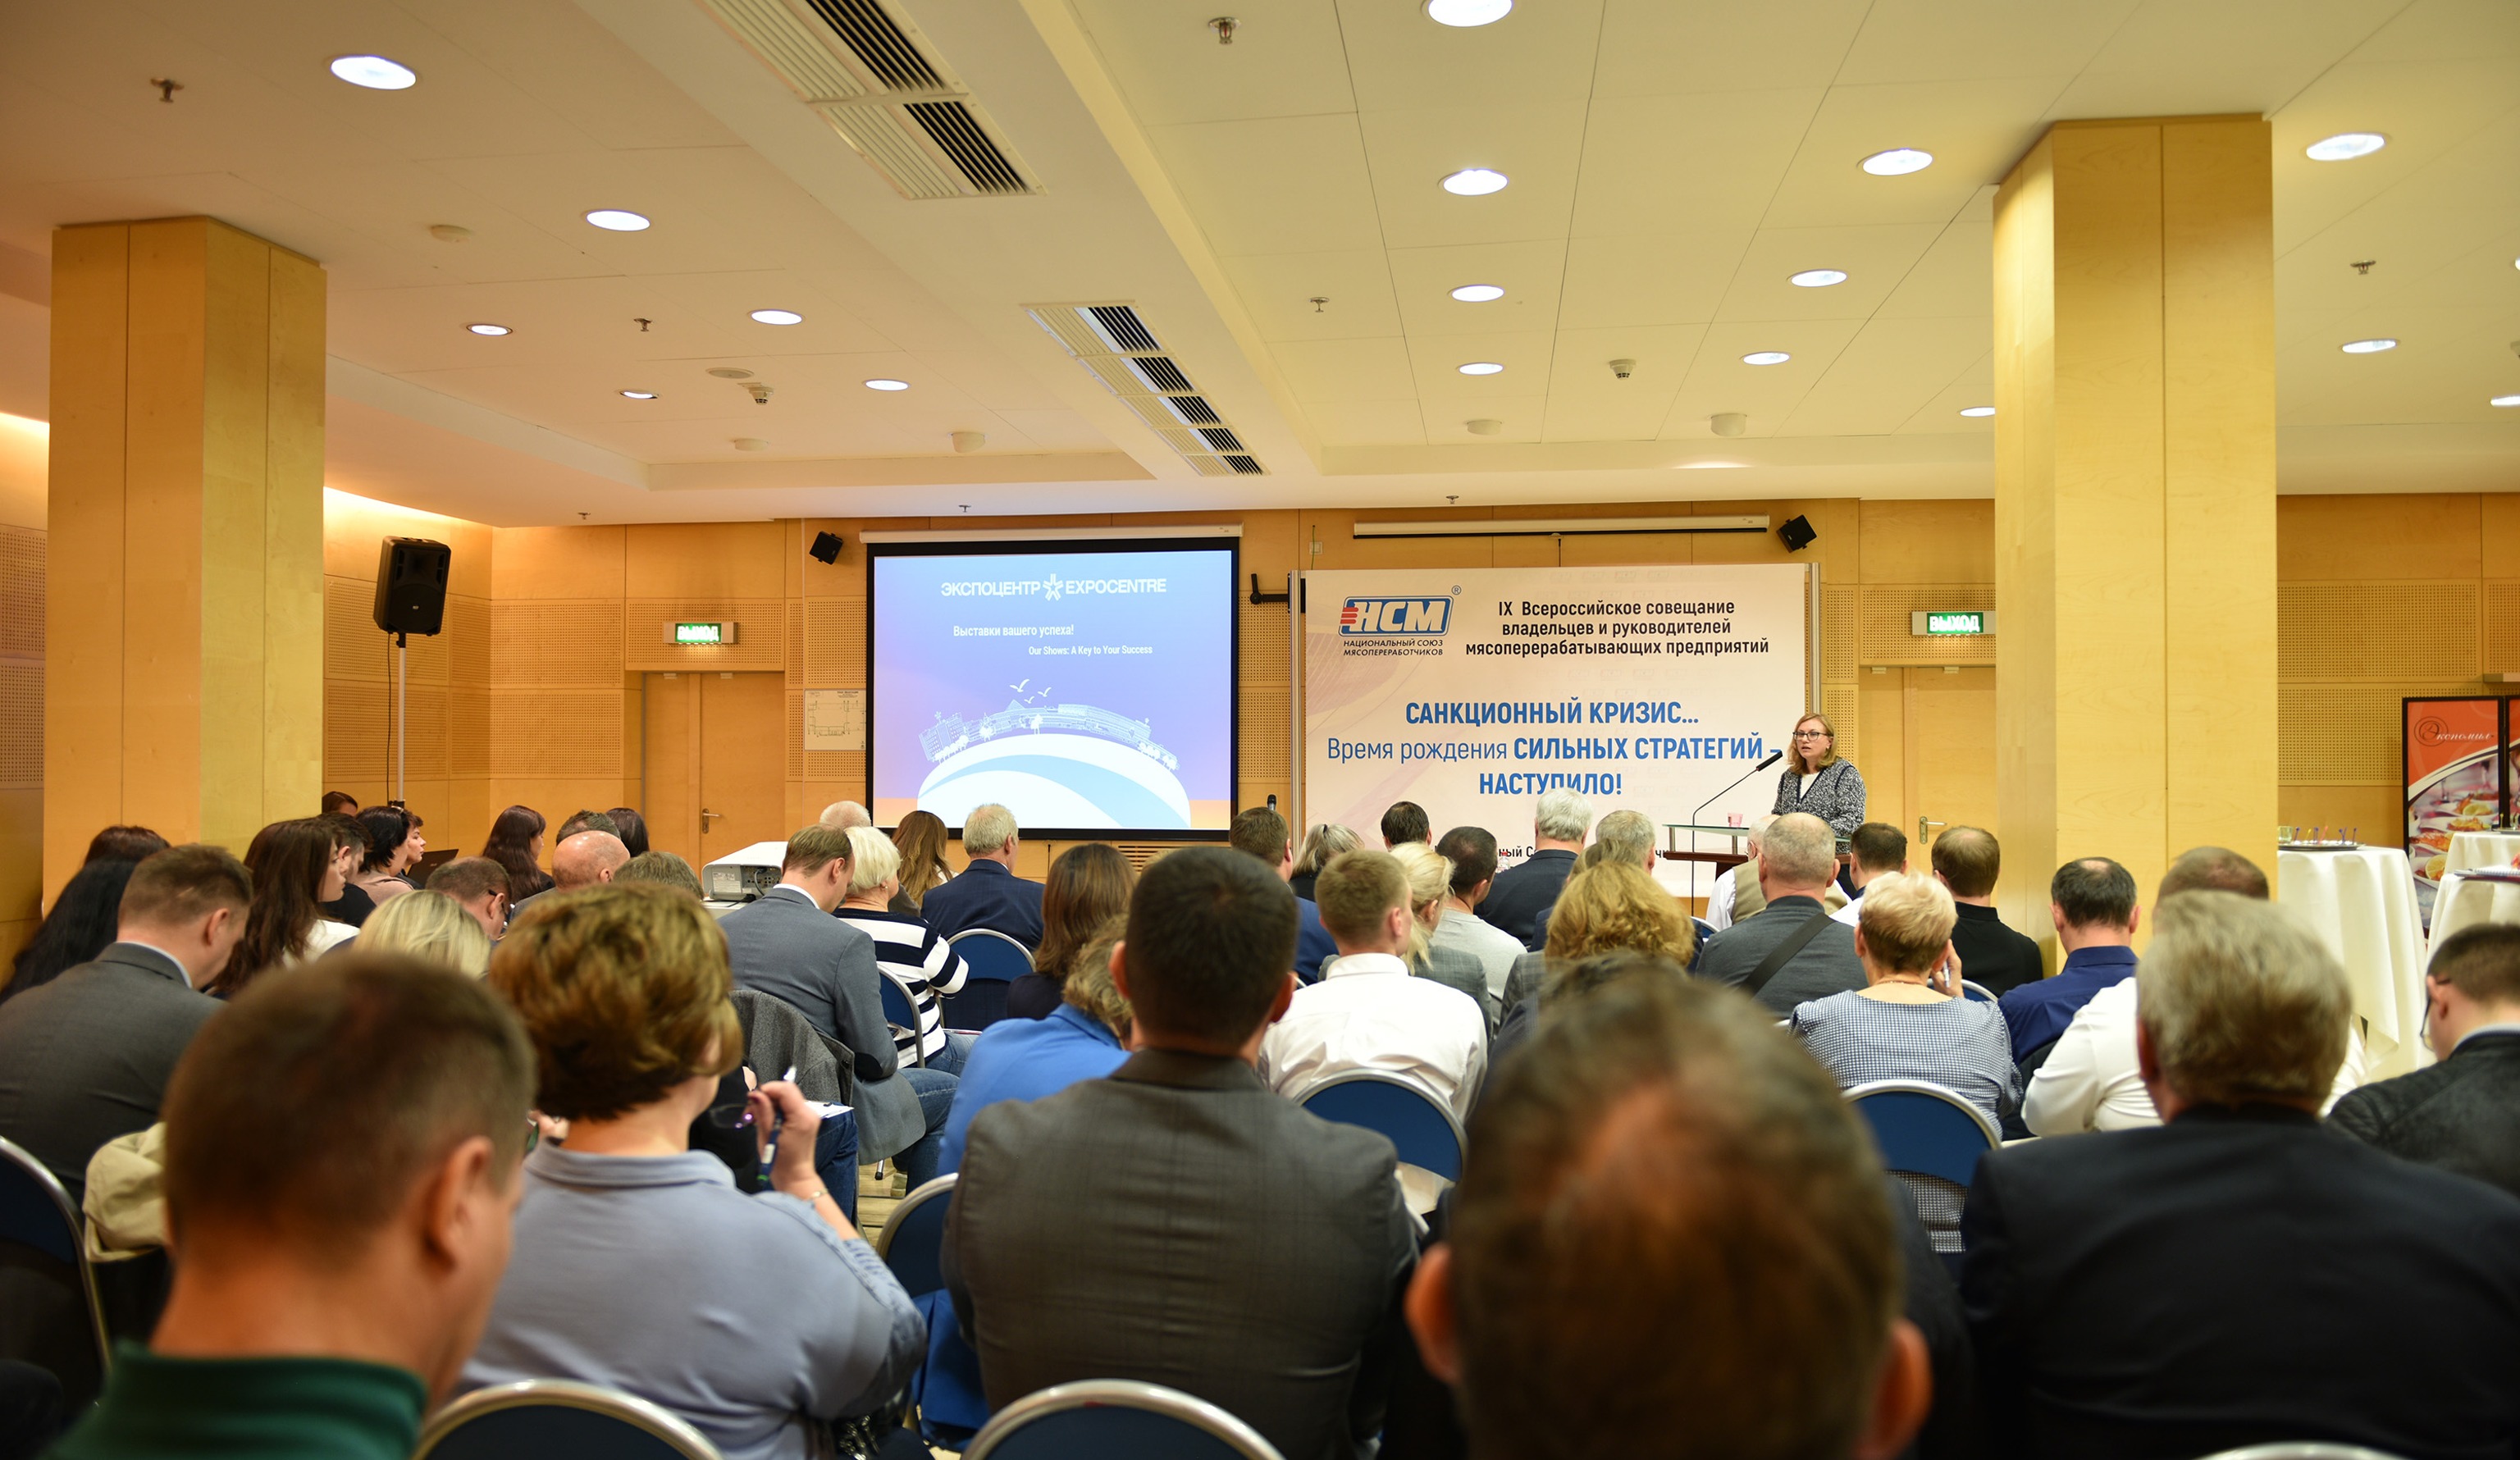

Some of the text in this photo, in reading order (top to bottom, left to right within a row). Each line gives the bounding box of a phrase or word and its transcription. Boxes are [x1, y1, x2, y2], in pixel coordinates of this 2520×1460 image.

[941, 582, 1041, 597] ЭКСПОЦЕНТР
[1066, 578, 1166, 595] EXPOCENTRE
[1349, 601, 1445, 632] НСМ
[1499, 600, 1735, 618] IX Всероссийское совещание
[954, 625, 1074, 638] Выставки вашего успеха!
[1502, 618, 1731, 637] владельцев и руководителей
[1929, 614, 1980, 632] ВЫХОД
[1029, 645, 1152, 657] Our Shows: A Key to Your Success
[1344, 639, 1415, 647] НАЦИОНАЛЬНЫЙ
[1467, 635, 1768, 658] мясоперерабатывающих предприятий
[1407, 697, 1581, 727] САНКЦИОННЫЙ
[1328, 738, 1393, 764] Время
[1401, 742, 1507, 764] рождения
[1514, 738, 1628, 759] СИЛЬНЫХ
[1636, 732, 1761, 759] СТРАТЕГИЙ
[1481, 773, 1621, 795] НАСТУПИЛО!
